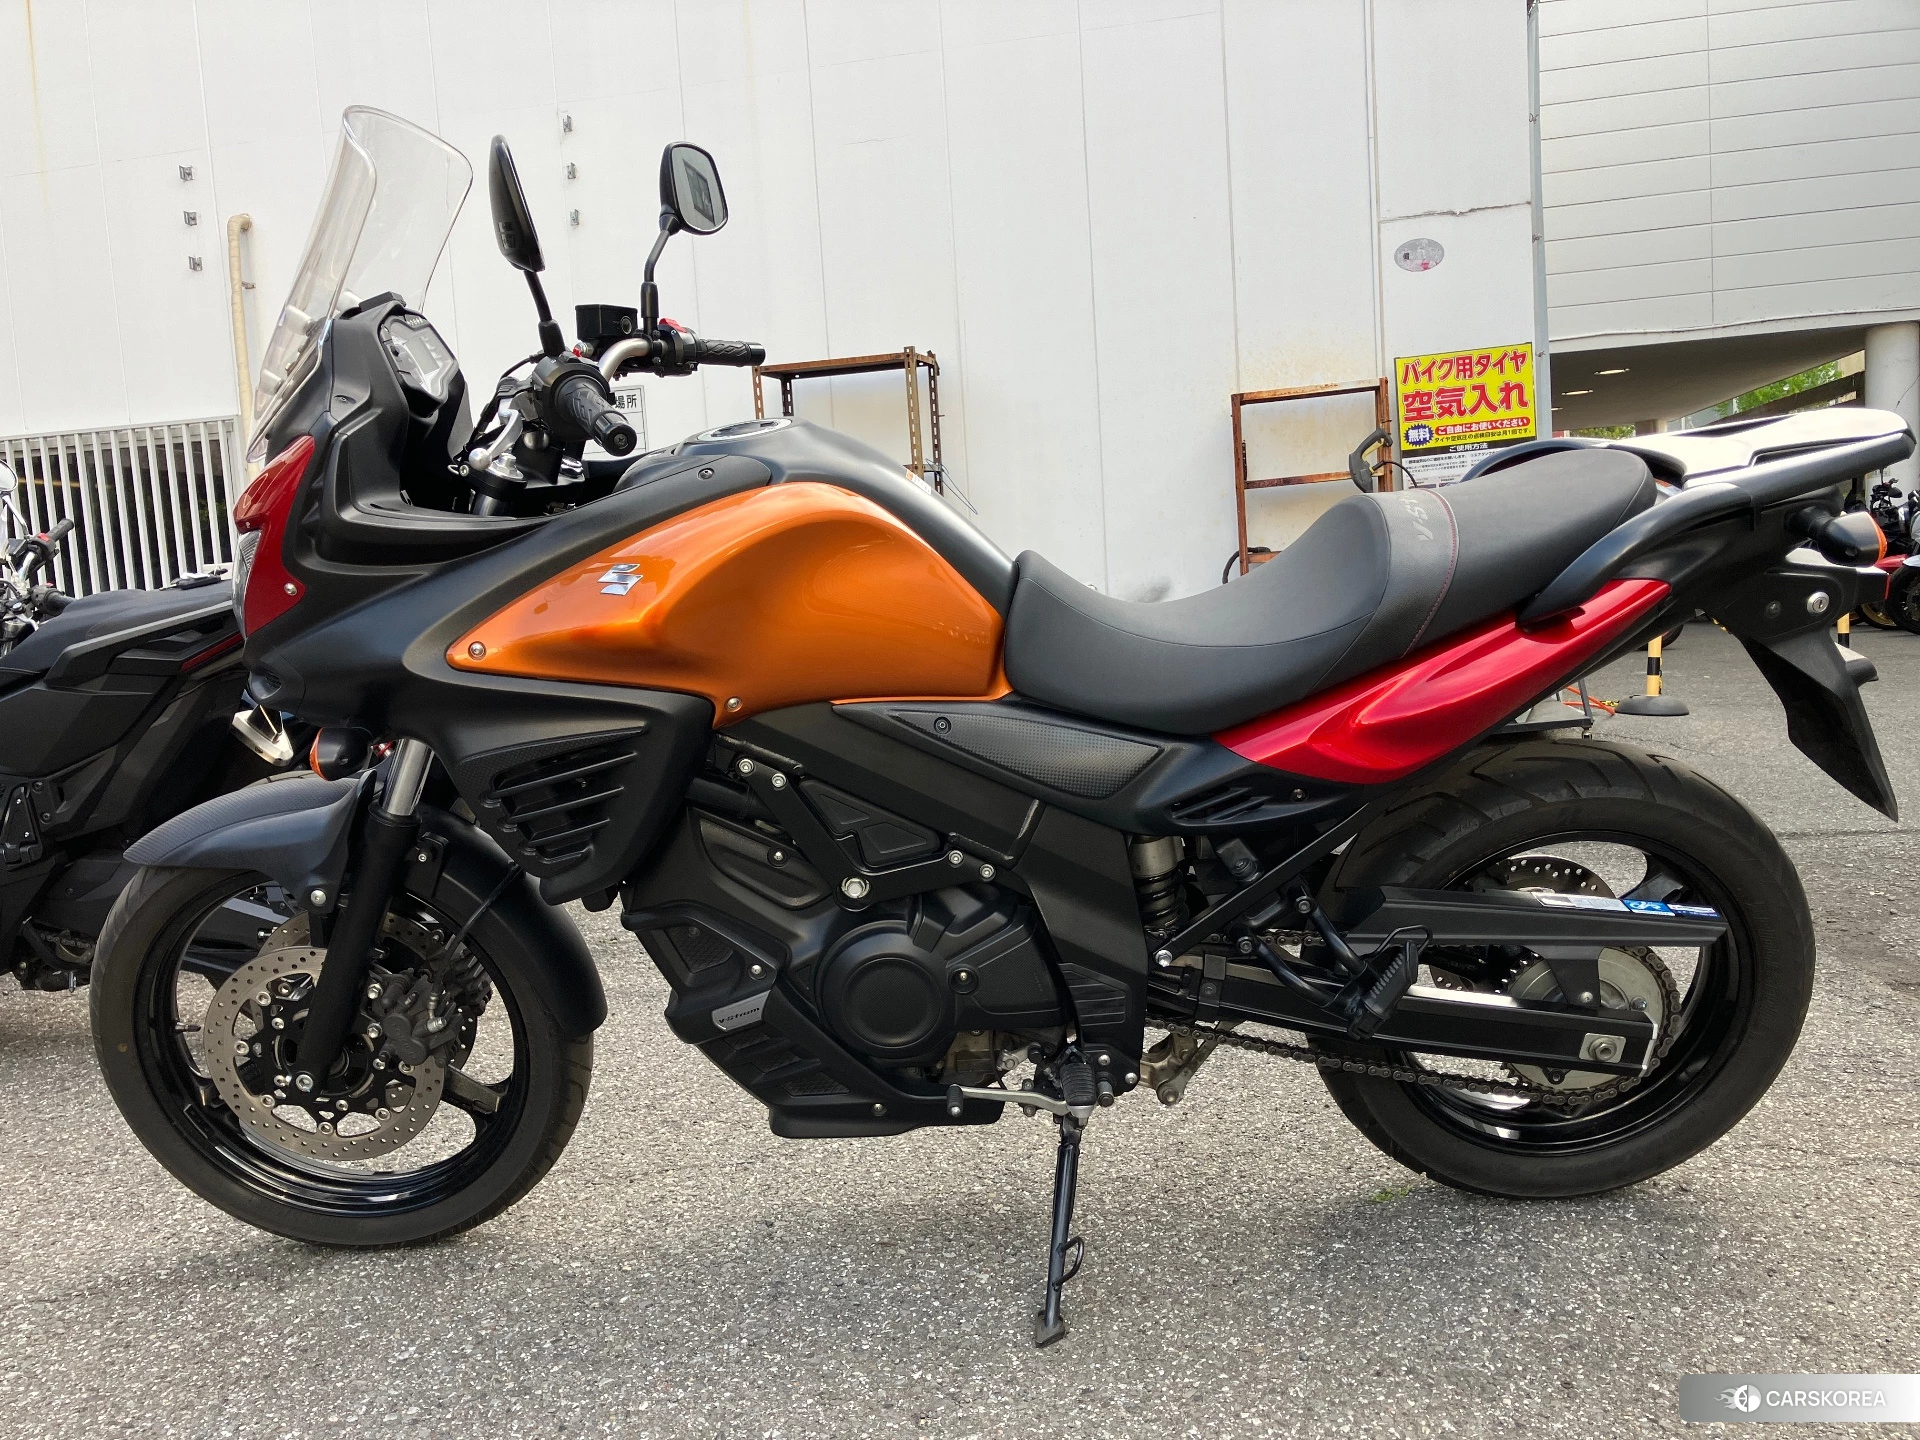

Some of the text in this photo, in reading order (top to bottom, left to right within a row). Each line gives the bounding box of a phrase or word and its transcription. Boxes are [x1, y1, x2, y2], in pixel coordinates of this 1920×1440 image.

[1402, 350, 1527, 385] バイク用タイヤ
[1403, 381, 1529, 422] 空気入れ
[1438, 418, 1527, 435] ご自由にお使いください
[1407, 428, 1431, 443] 無料
[718, 1007, 760, 1024] V-Strom
